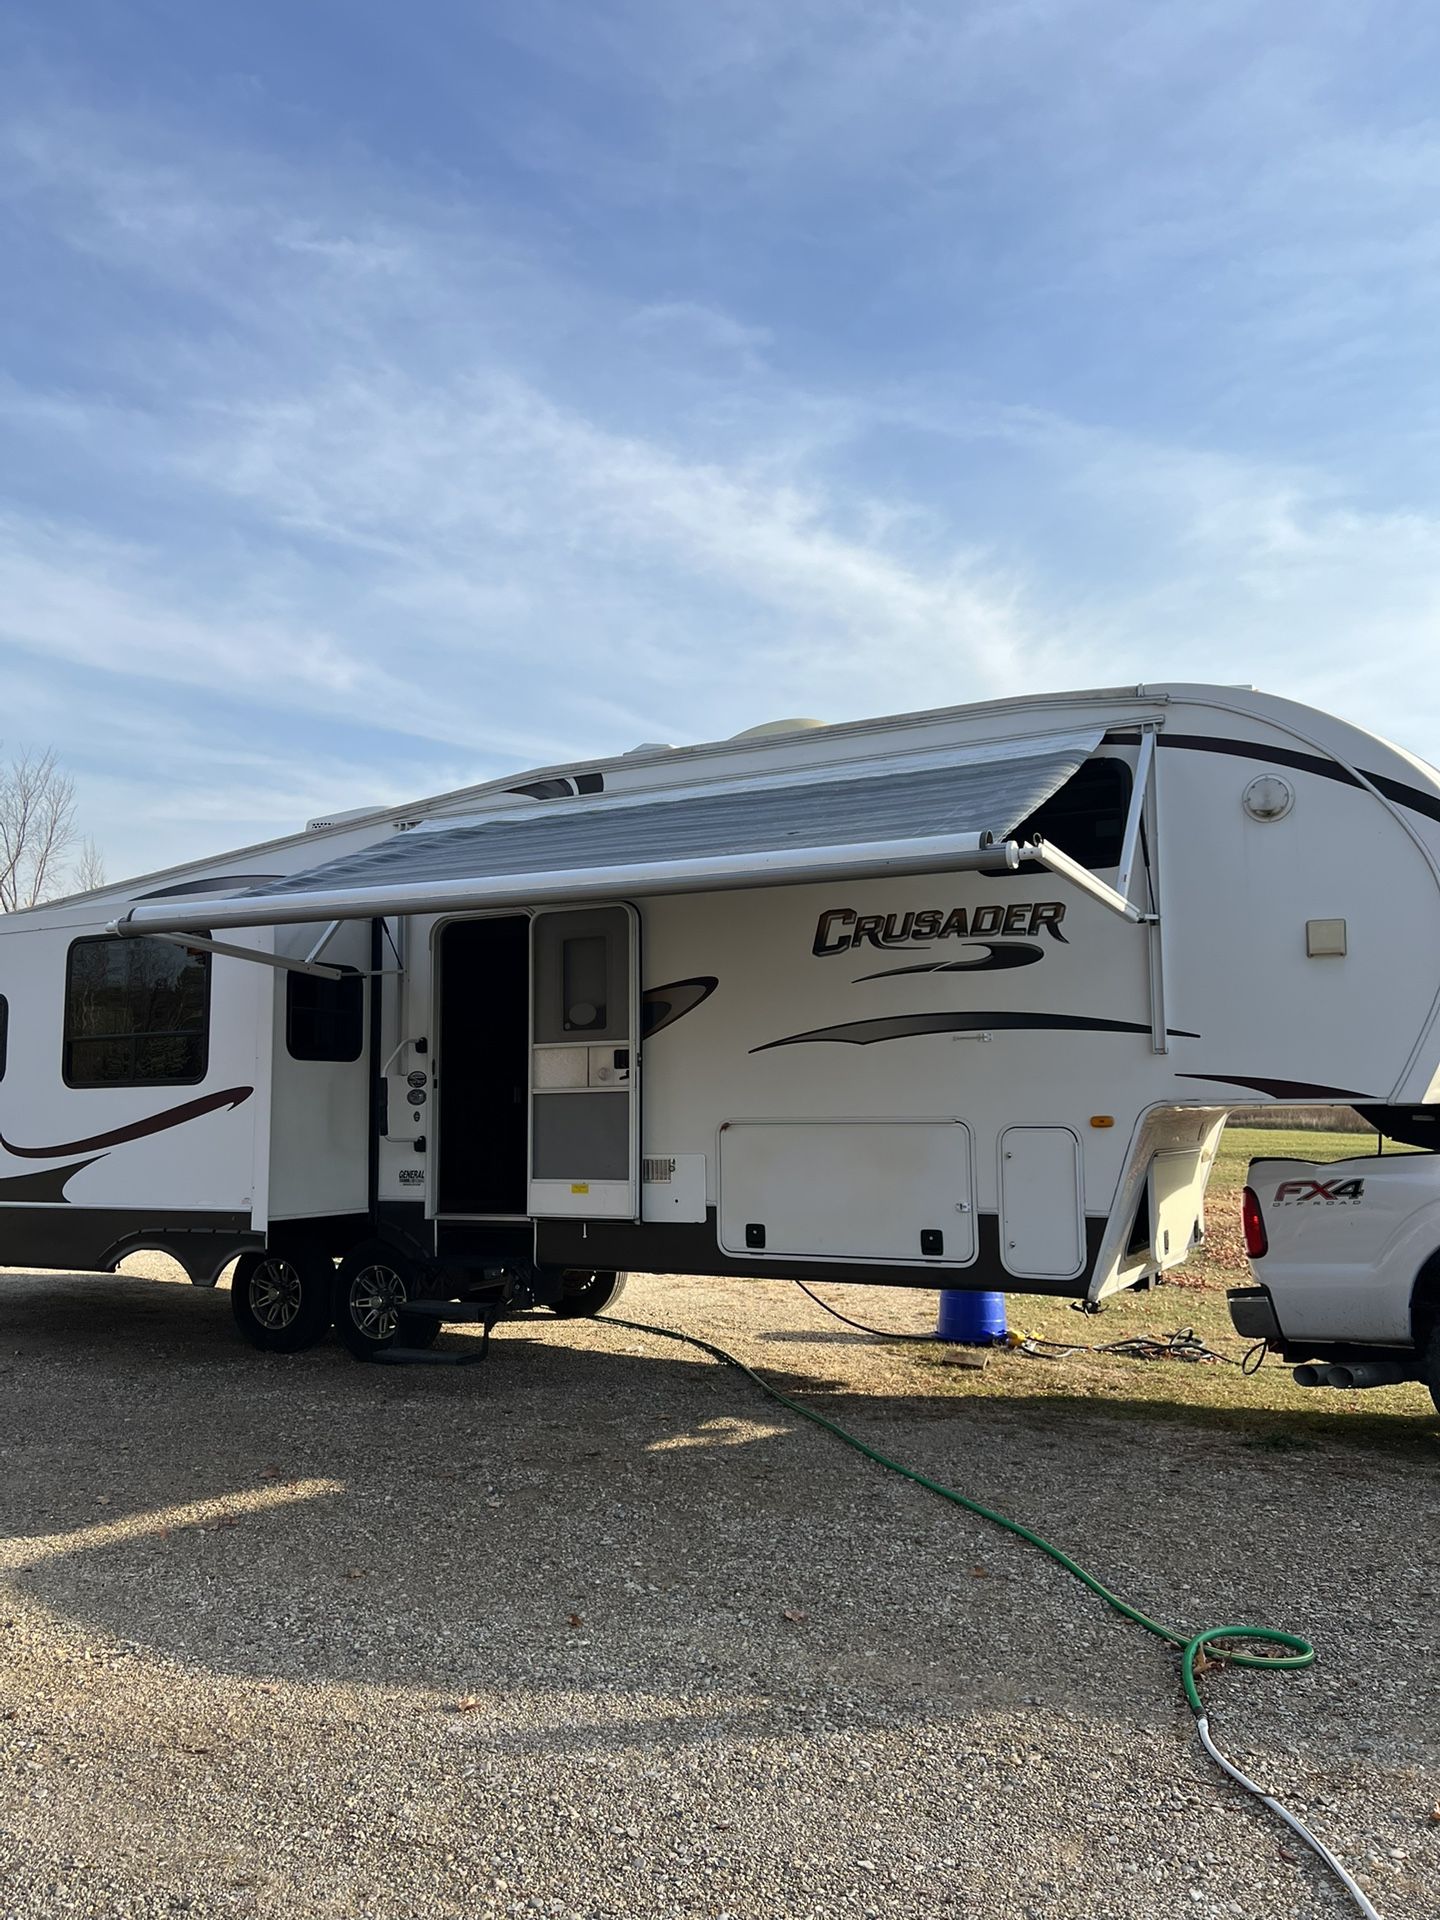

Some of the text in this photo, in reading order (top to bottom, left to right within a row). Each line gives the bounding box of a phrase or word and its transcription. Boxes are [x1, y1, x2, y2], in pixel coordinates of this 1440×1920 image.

[812, 901, 1070, 957] CRUSADER
[399, 1170, 424, 1178] GENERAL
[1274, 1178, 1365, 1201] FX4
